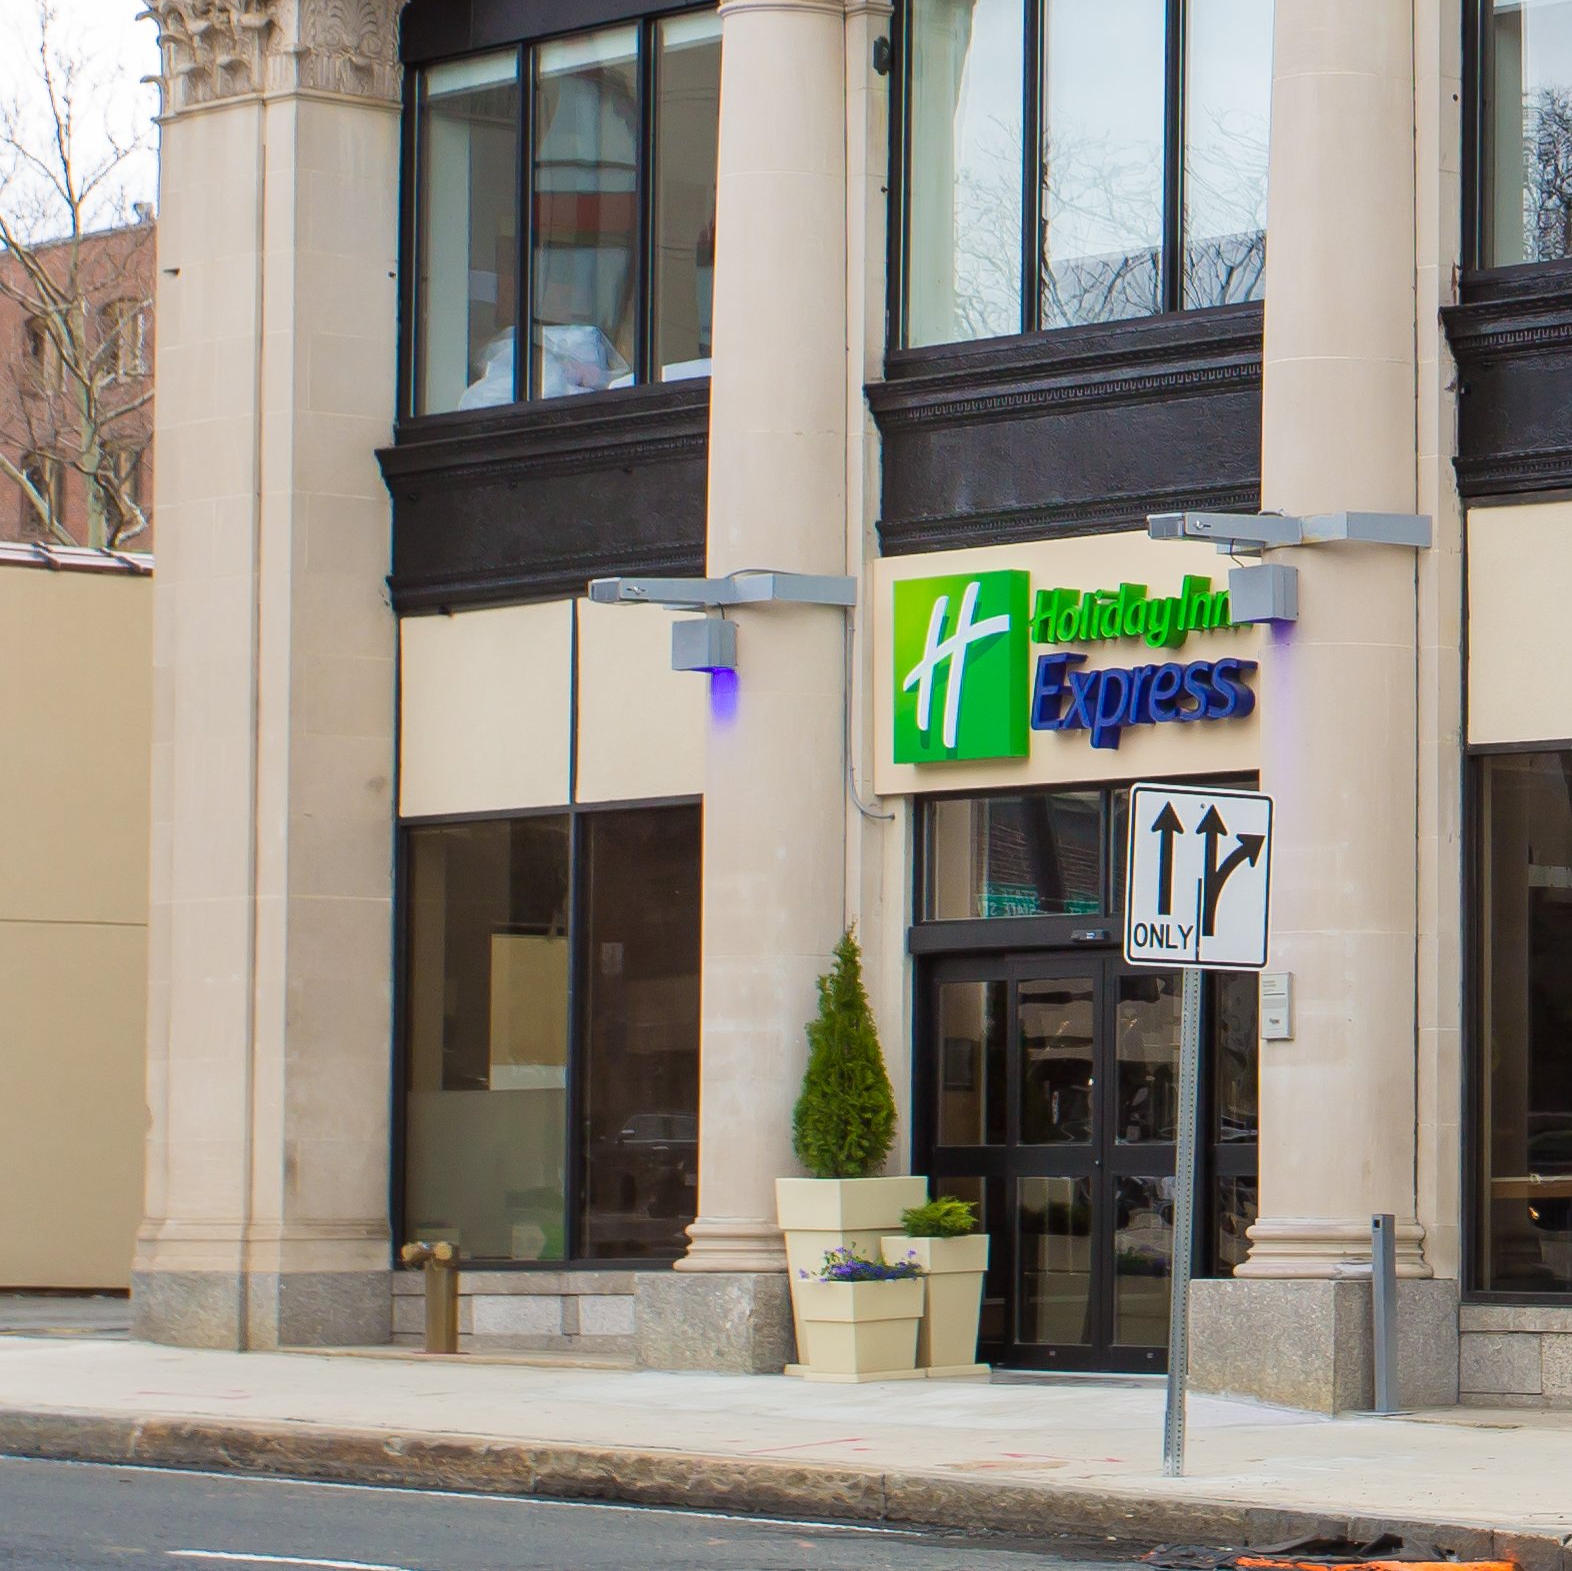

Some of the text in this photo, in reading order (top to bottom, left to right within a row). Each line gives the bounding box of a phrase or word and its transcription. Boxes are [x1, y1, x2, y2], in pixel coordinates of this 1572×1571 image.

[1030, 575, 1233, 649] Holiday Inn
[1031, 652, 1258, 749] Express
[1134, 923, 1194, 949] ONLY
